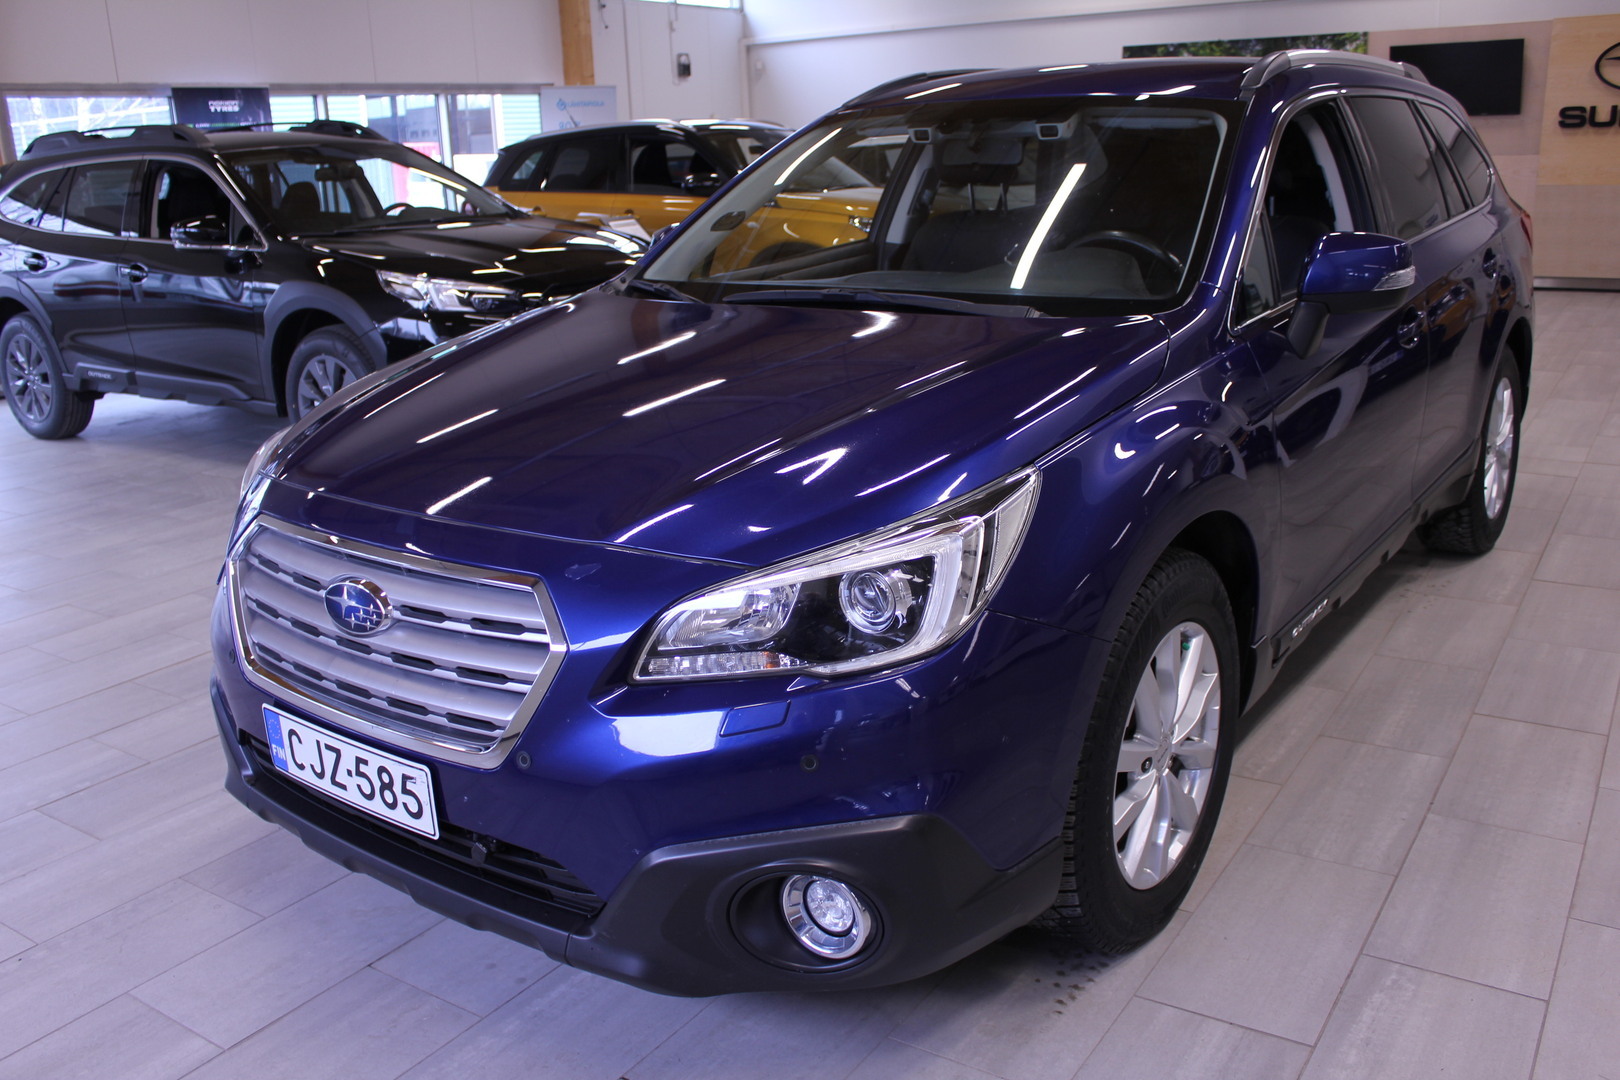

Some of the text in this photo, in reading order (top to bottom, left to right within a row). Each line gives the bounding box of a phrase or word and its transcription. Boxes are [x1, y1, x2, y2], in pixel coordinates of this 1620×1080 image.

[1558, 105, 1620, 128] SU
[272, 744, 286, 760] FIN
[287, 728, 424, 820] CJZ-585
